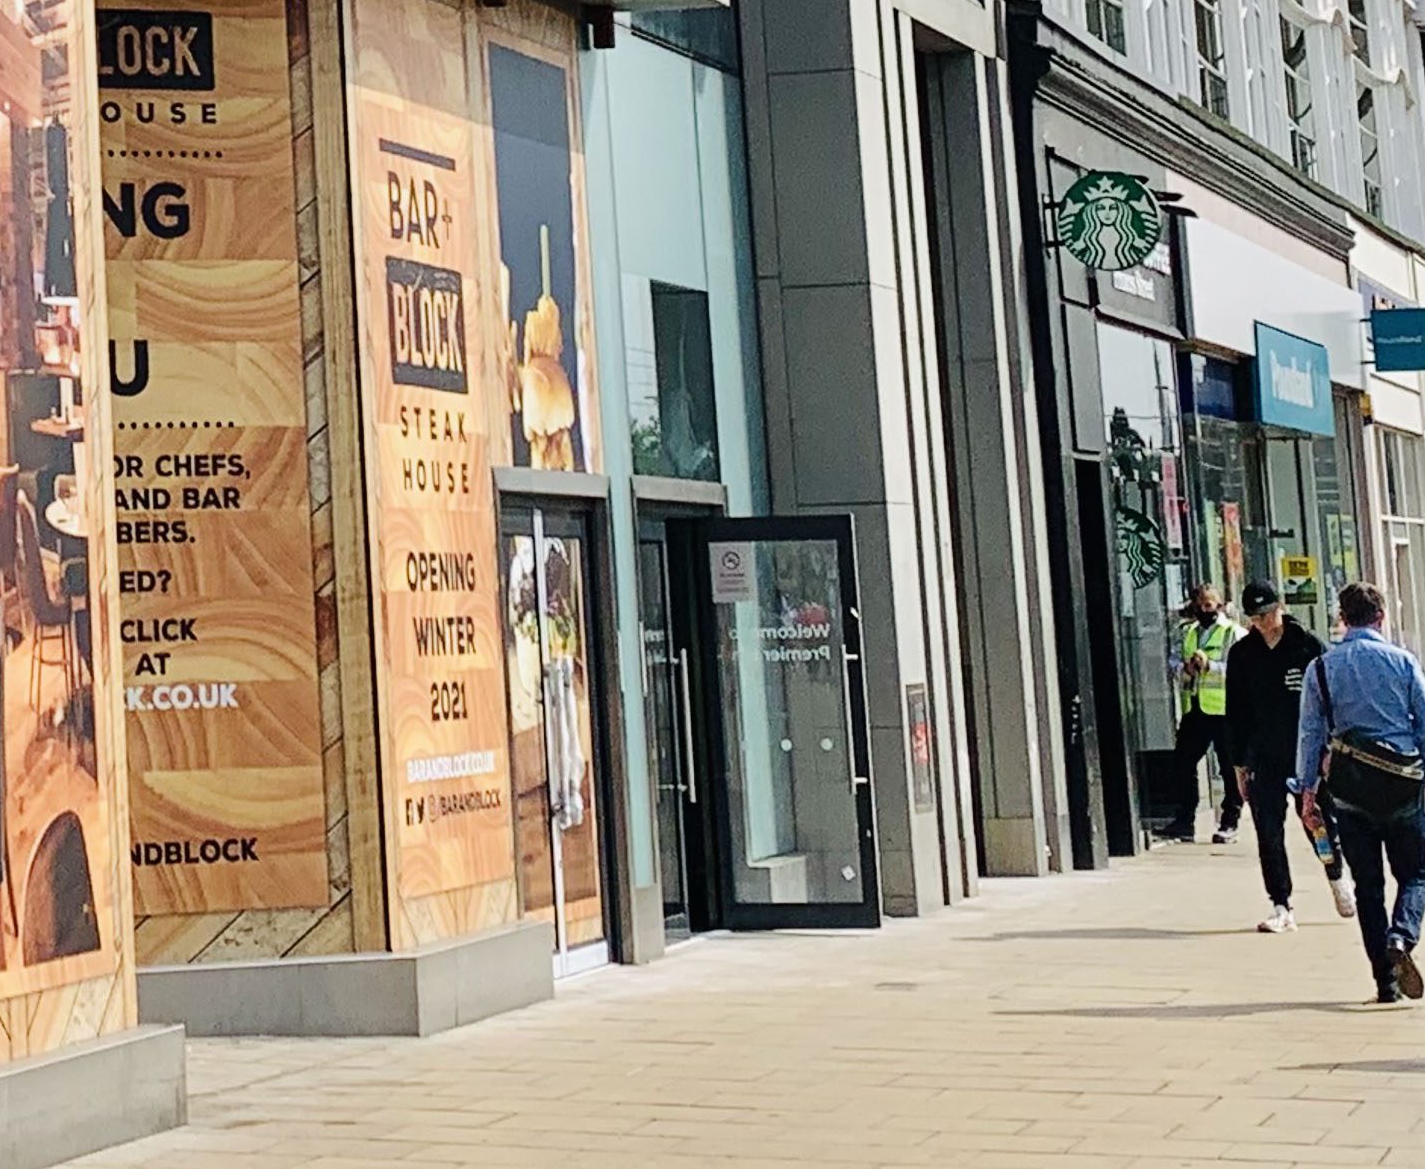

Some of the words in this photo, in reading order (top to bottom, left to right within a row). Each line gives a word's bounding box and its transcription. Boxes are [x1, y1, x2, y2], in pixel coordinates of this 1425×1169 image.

[101, 101, 217, 124] OUSE
[391, 280, 463, 373] BLOCK
[108, 339, 149, 397] U
[400, 405, 468, 445] STEAK
[155, 454, 251, 480] CHEFS,
[402, 458, 470, 494] HOUSE
[115, 488, 171, 510] AND
[182, 487, 240, 509] BAR
[116, 520, 196, 544] BERS.
[119, 569, 172, 593] ED?
[406, 551, 475, 592] OPENING
[120, 618, 198, 643] CLICK
[413, 616, 476, 657] WINTER
[135, 653, 171, 676] AT
[123, 683, 239, 710] K.CO.UK
[430, 681, 468, 722] 2021
